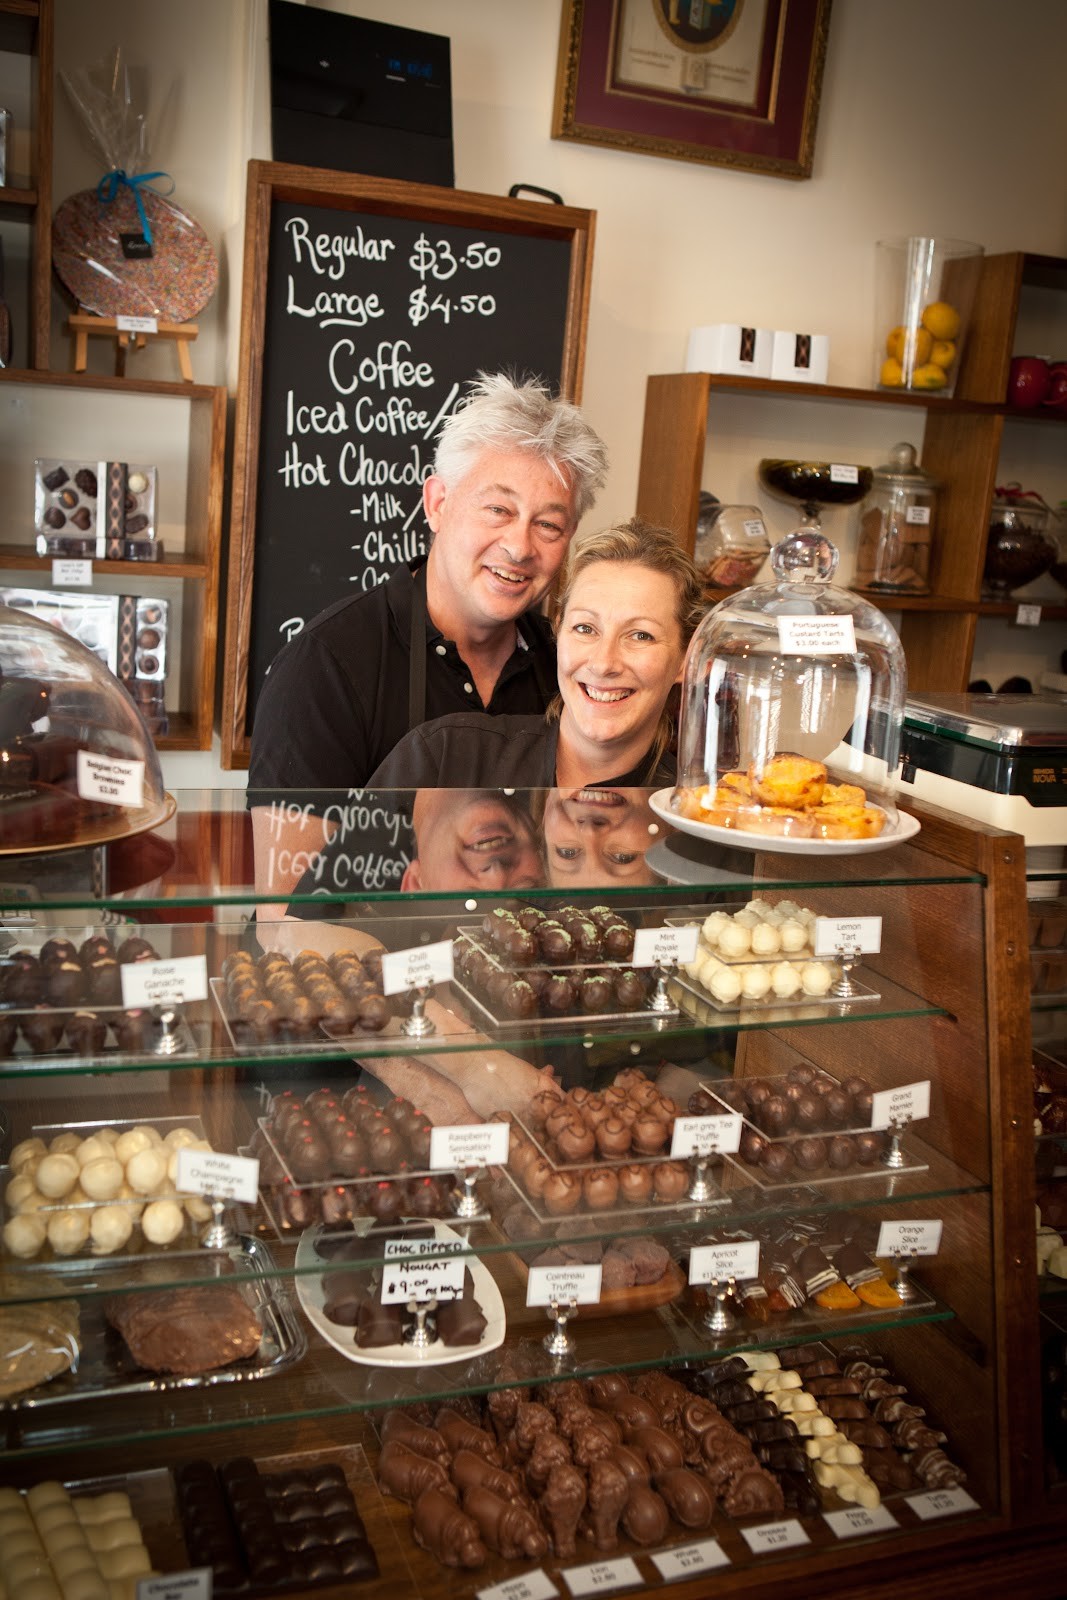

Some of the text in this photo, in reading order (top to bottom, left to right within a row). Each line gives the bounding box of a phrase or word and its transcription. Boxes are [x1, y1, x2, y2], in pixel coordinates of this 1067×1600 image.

[285, 217, 501, 280] Regular $3.50
[287, 275, 496, 326] Large $4.50
[329, 338, 435, 395] Coffee
[286, 390, 348, 437] Iced
[278, 441, 437, 488] Hot Chocola
[836, 923, 862, 931] Lemon
[841, 933, 857, 941] Tart
[654, 944, 679, 953] Royale
[409, 951, 429, 963] Chilli
[144, 977, 186, 990] Ganache
[892, 1091, 913, 1103] Grand
[683, 1123, 699, 1131] Earl
[719, 1120, 734, 1129] Tea
[448, 1132, 493, 1142] Raspberry
[695, 1132, 720, 1141] Truffle
[448, 1143, 492, 1152] Sensation
[203, 1159, 230, 1171] White
[190, 1168, 244, 1184] Champagne
[898, 1226, 925, 1235] Orange
[902, 1235, 919, 1244] Slice
[387, 1242, 416, 1255] CHOC
[711, 1249, 739, 1259] Apricot
[715, 1261, 734, 1269] Slice
[545, 1272, 586, 1281] Cointreau
[552, 1282, 578, 1291] Truffle
[589, 1565, 610, 1575] Lion
